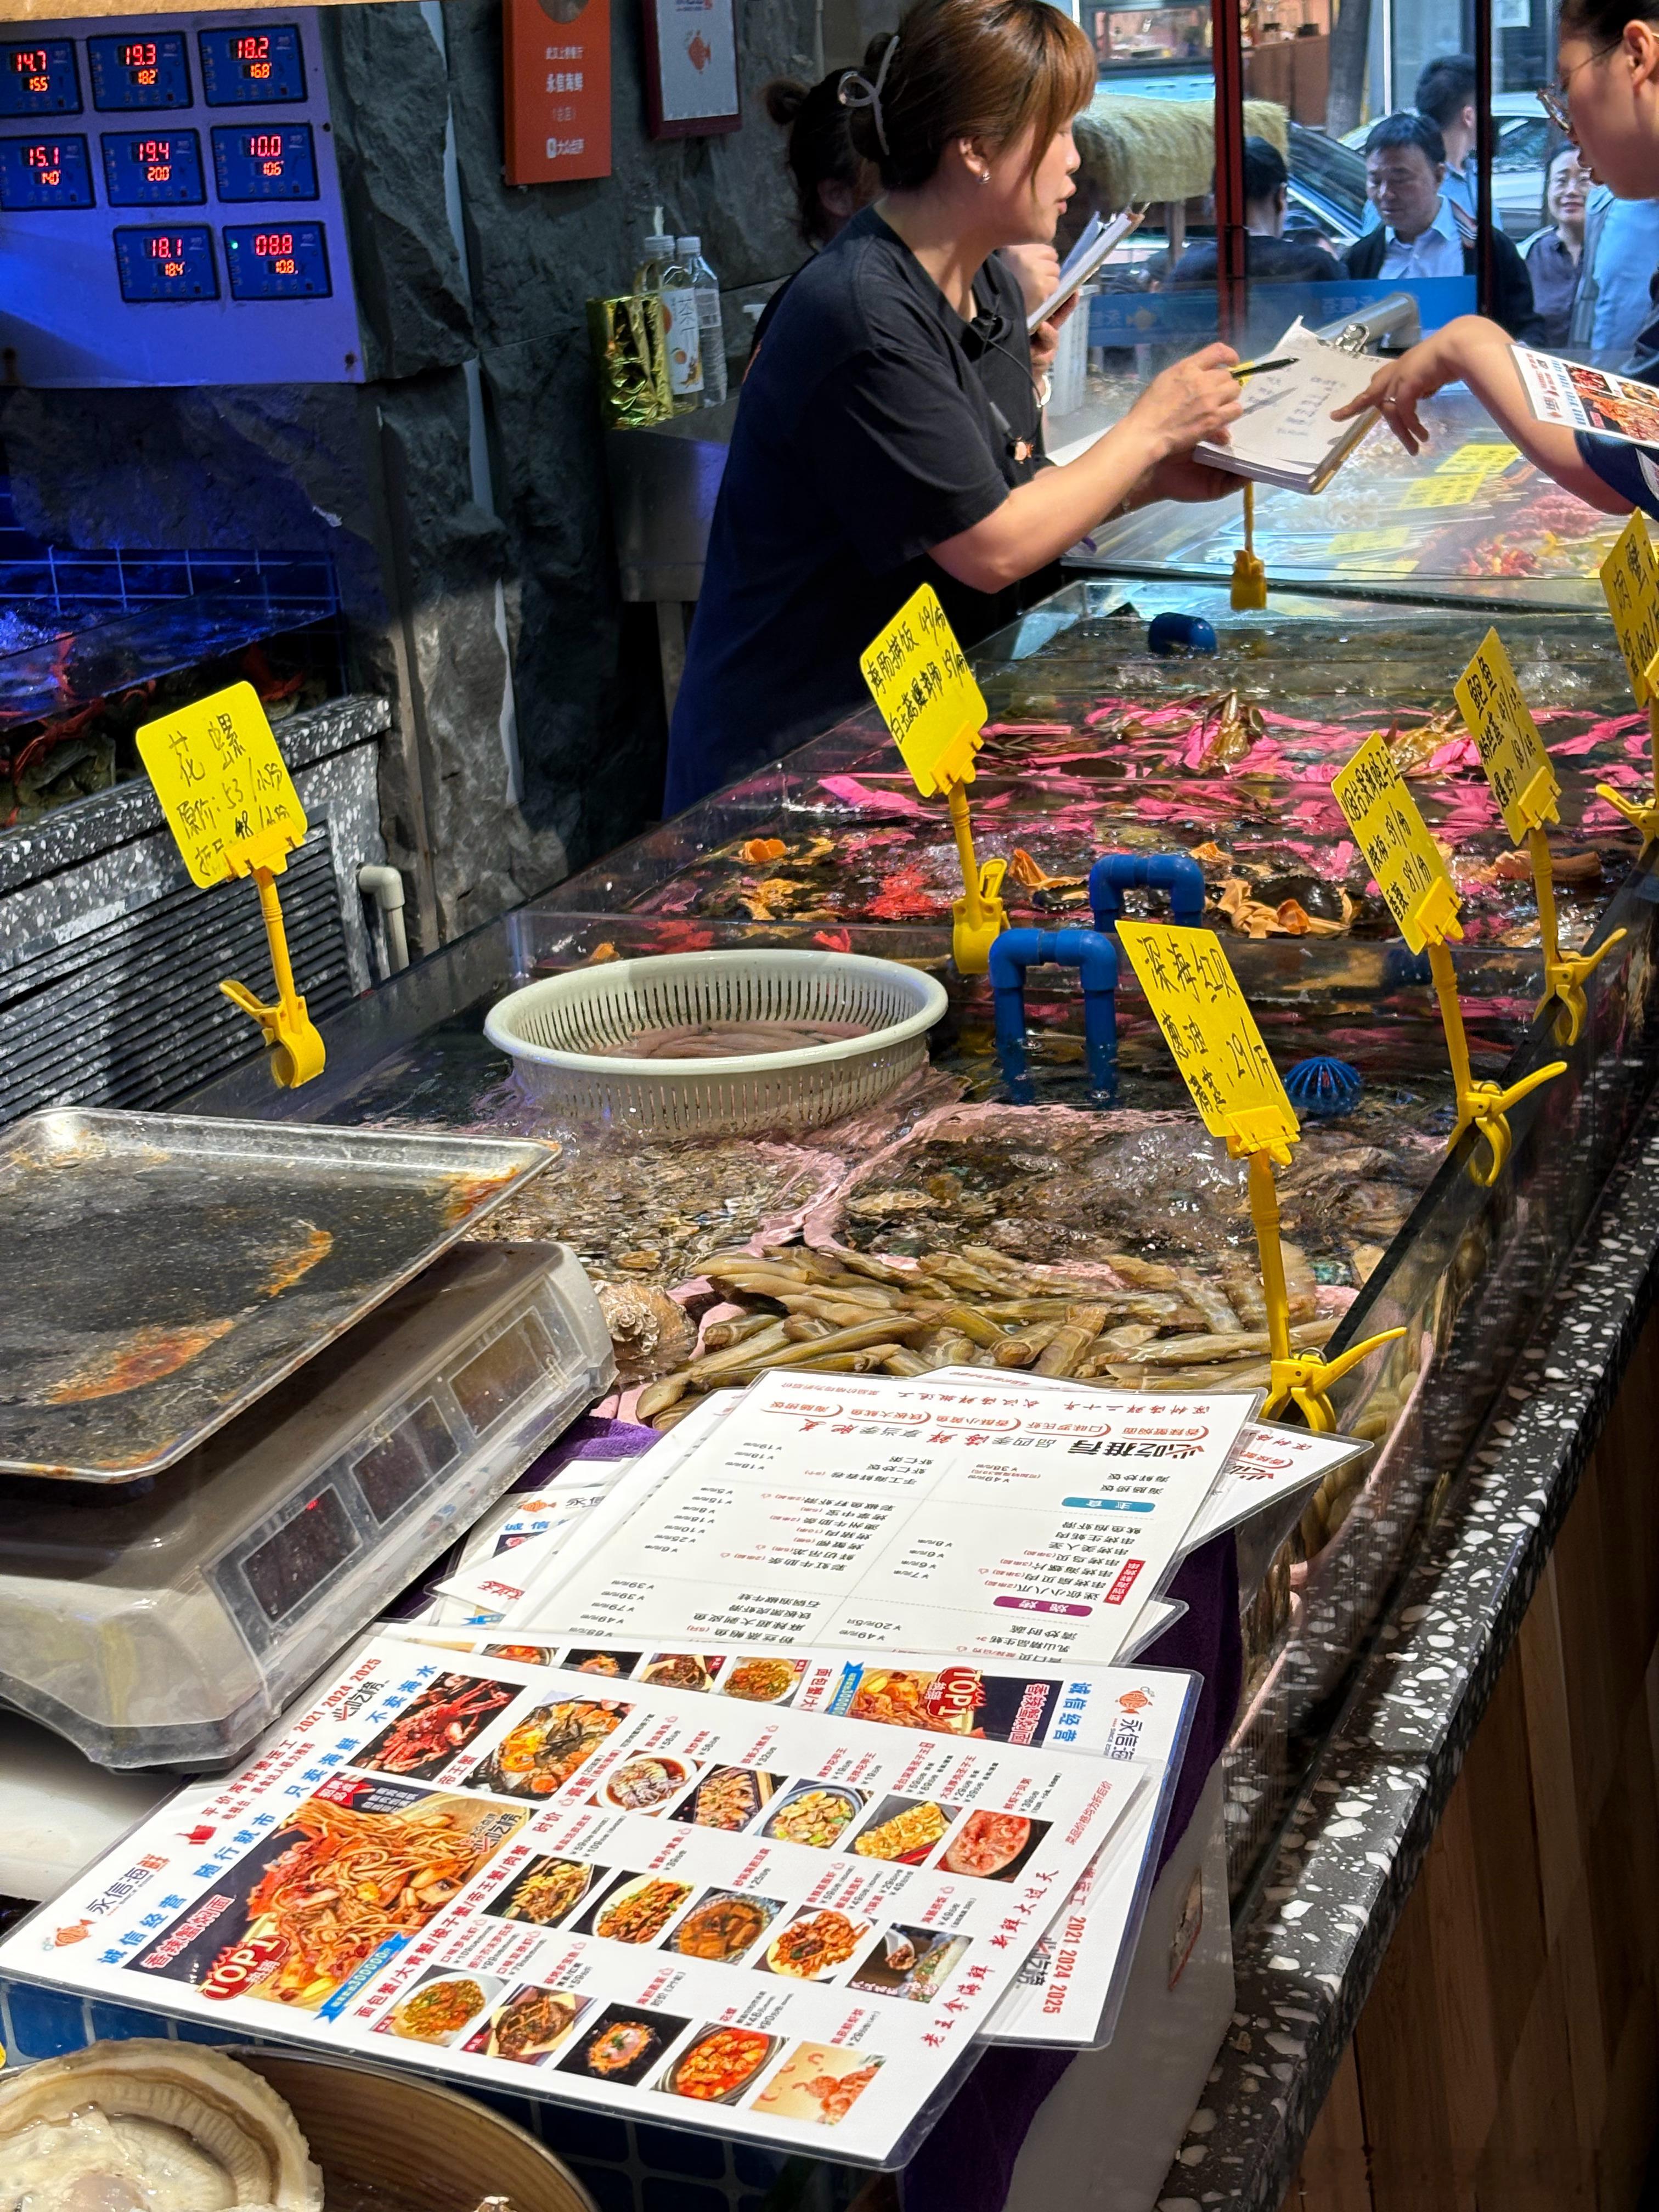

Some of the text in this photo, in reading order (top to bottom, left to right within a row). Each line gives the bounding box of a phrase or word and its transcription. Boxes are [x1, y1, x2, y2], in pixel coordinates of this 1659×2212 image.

[16, 51, 47, 72] 14.7
[125, 44, 156, 65] 19.3
[238, 37, 268, 59] 18.2
[29, 146, 59, 167] 15.1
[139, 141, 169, 162] 19.4
[250, 136, 281, 156] 10.0
[151, 238, 182, 258] 18.1
[1465, 656, 1498, 720] 鲍鱼
[1107, 1473, 1170, 1482] 海鲜炒饭
[332, 1681, 384, 1722] 必吃榜
[801, 1667, 831, 1713] 面包蟹/大
[935, 1666, 983, 1719] TOP1
[1007, 1681, 1051, 1746] 香辣蟹焖面
[1053, 1682, 1091, 1741] 诚信经营
[87, 1854, 168, 1913] 永信海鲜
[202, 1740, 296, 1815] 平价海鲜搬运工
[292, 1711, 325, 1732] 2021
[321, 1685, 353, 1707] 2024
[349, 1658, 381, 1681] 2025
[98, 1665, 436, 1963] 诚信经营 随行就市 只卖海鲜 不卖海水
[241, 1754, 477, 1985] 热销 帝王蟹
[138, 1893, 238, 1970] 香辣蟹焖面
[356, 1846, 529, 2017] 面包蟹/大青蟹/梭子蟹/帝王蟹/肉蟹
[532, 1812, 562, 1832] 时价
[1063, 1915, 1086, 1943] 2021
[194, 1934, 283, 1998] TOP1
[1053, 1949, 1077, 1978] 2024
[1042, 1984, 1067, 2013] 2025
